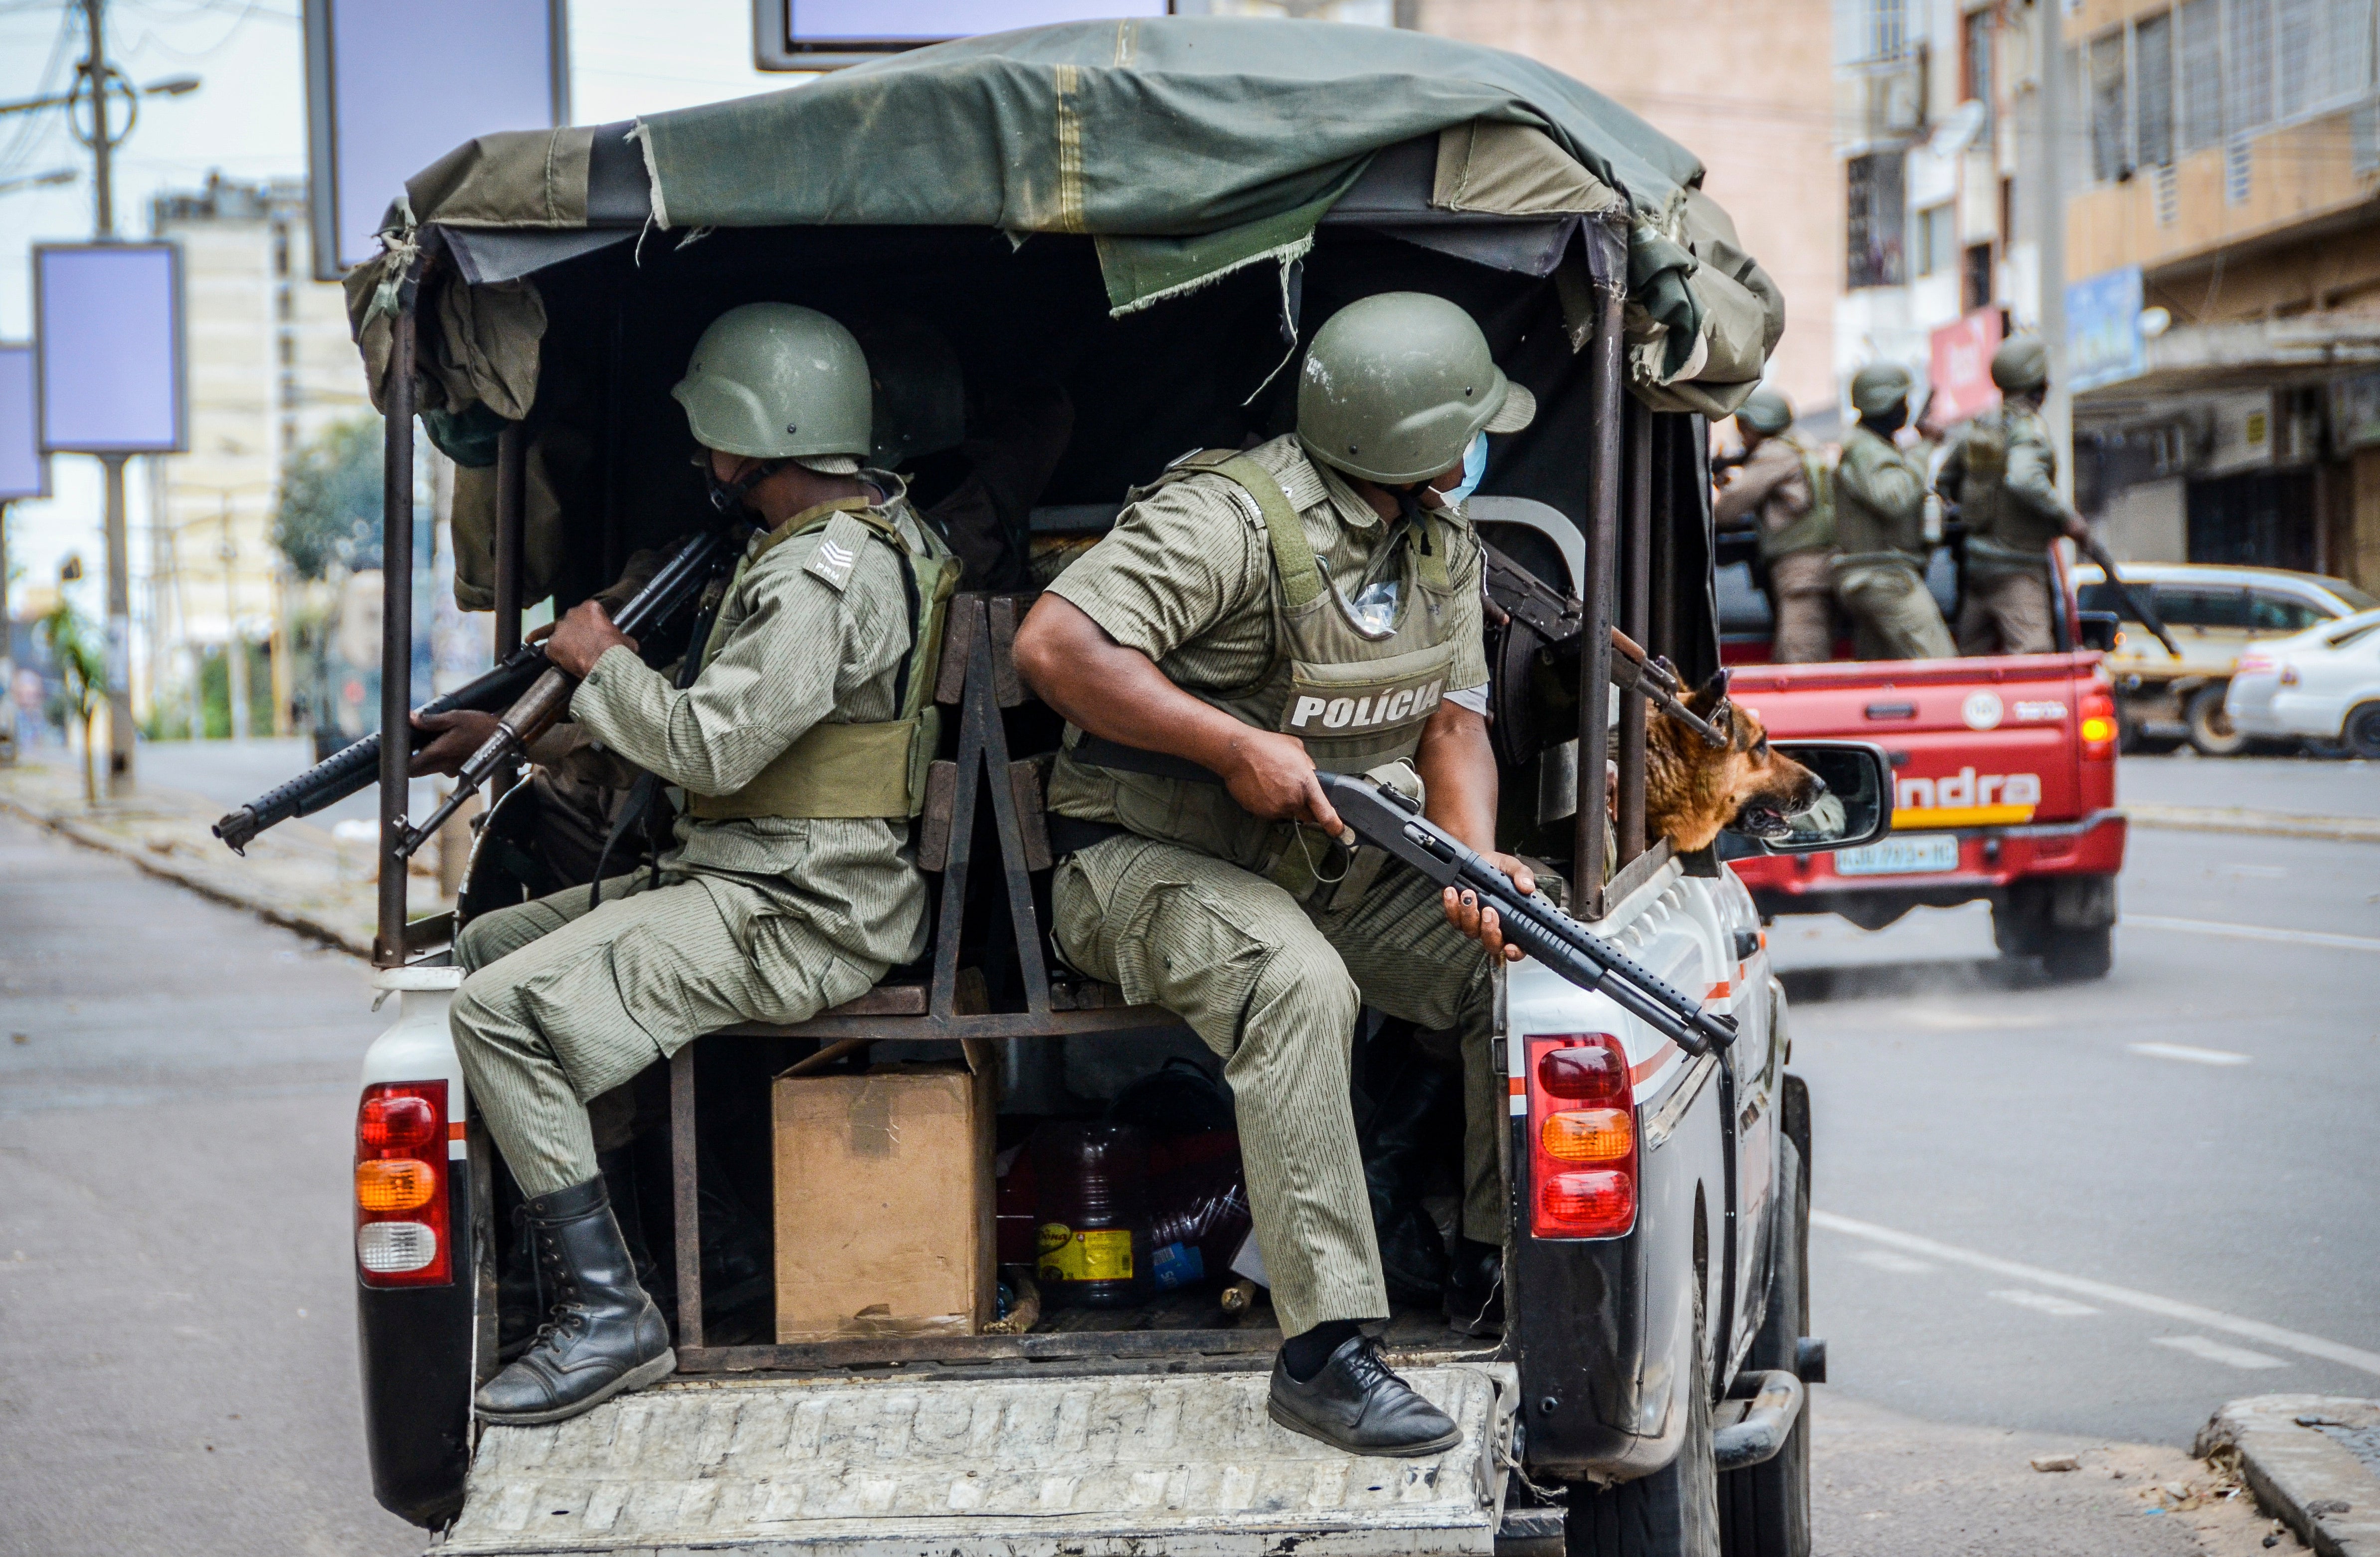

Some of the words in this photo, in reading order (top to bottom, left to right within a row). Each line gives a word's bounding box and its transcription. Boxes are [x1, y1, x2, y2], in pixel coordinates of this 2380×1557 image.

[1242, 494, 1262, 515] PRM
[816, 562, 840, 581] PRM
[1291, 678, 1443, 728] POLÍCIA
